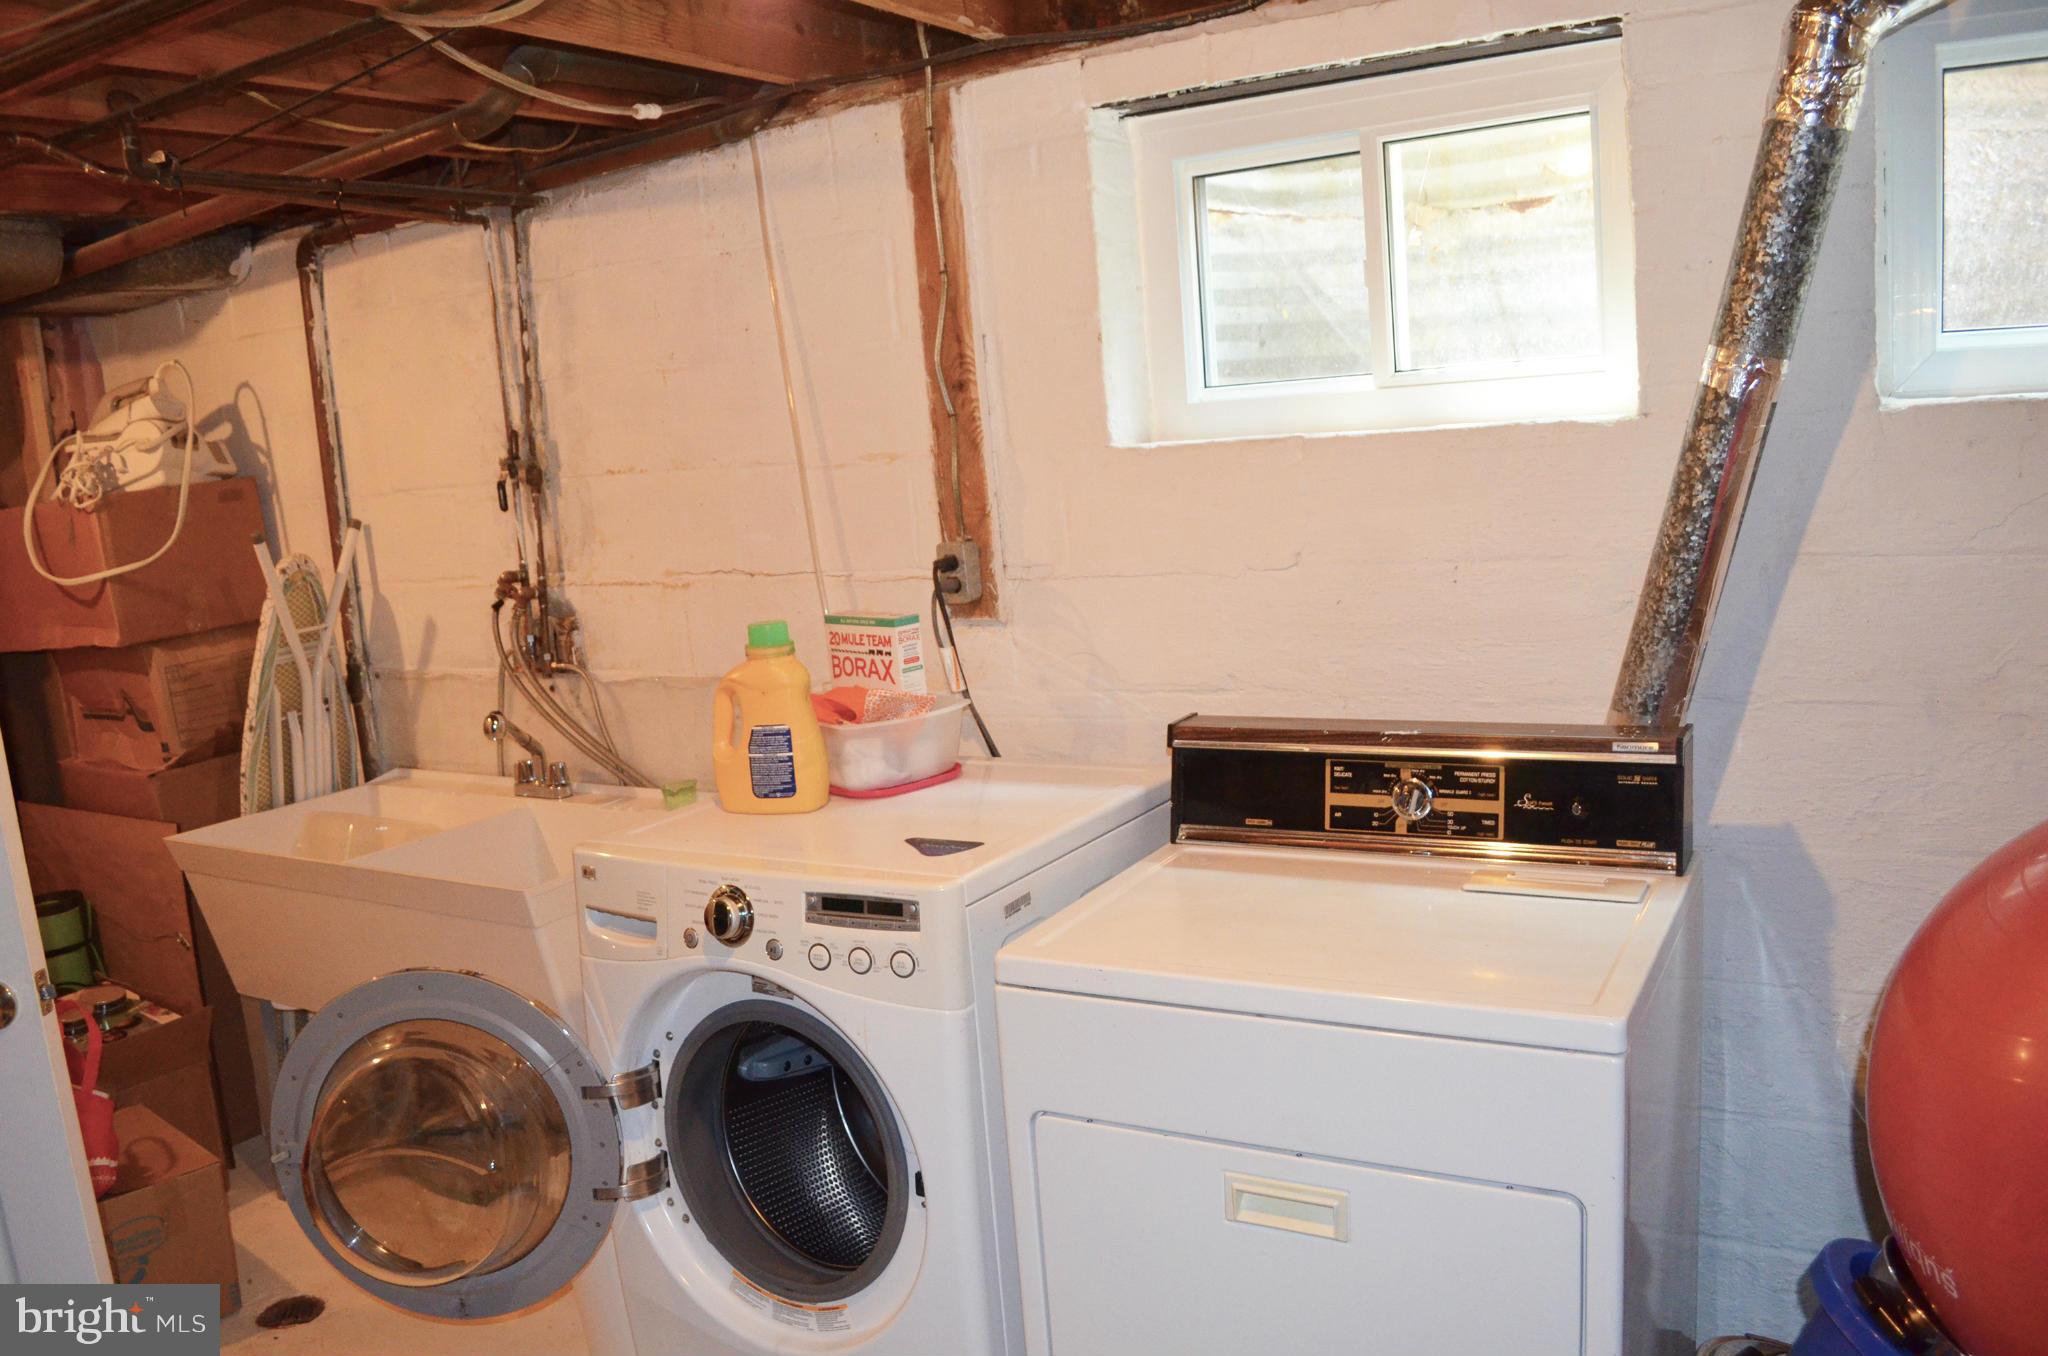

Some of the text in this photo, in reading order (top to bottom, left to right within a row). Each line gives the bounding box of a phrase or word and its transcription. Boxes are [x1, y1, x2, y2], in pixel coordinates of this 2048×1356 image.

[829, 631, 892, 648] 20 MULE TEAM
[831, 654, 896, 685] BORAX
